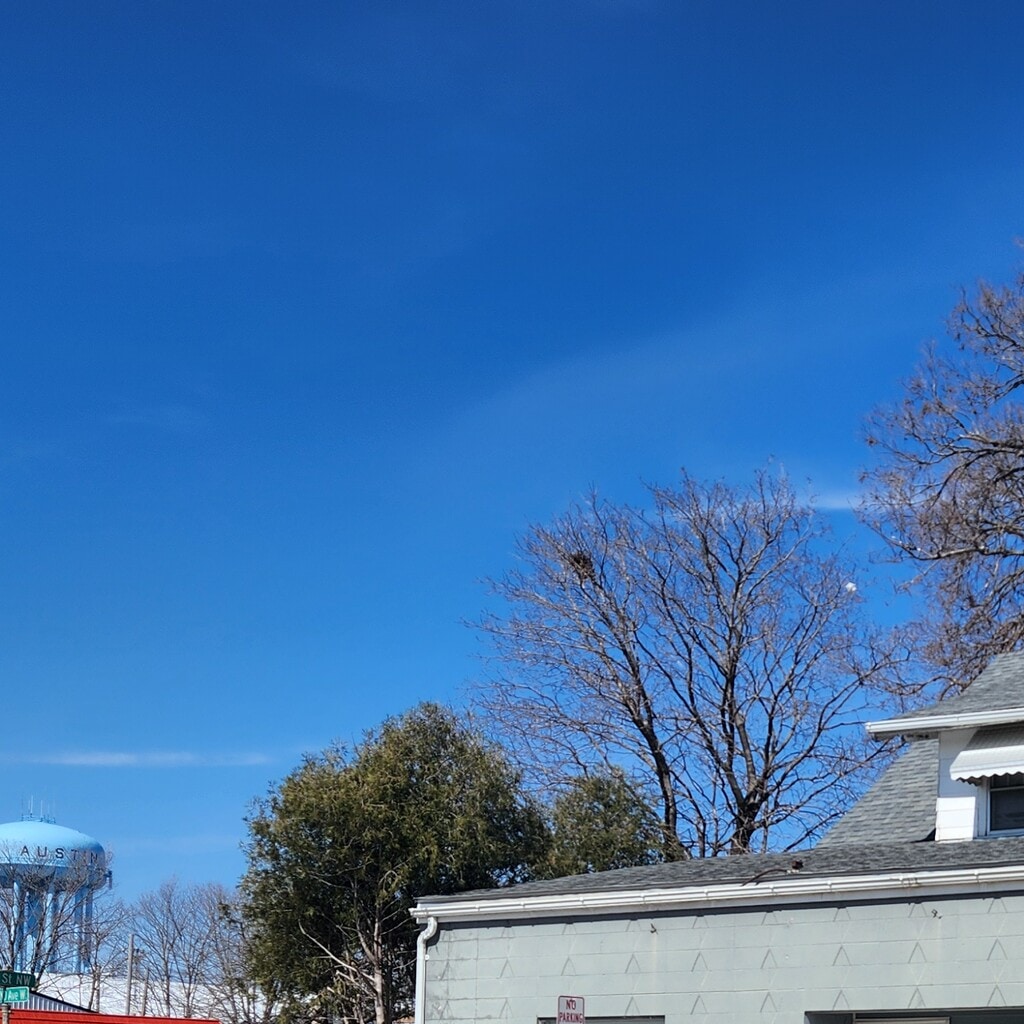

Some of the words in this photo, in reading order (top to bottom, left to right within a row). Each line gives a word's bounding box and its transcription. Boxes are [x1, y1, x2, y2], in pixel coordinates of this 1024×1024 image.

[20, 845, 98, 863] AUSTIN
[1, 972, 12, 984] St
[16, 974, 32, 985] NW
[7, 990, 18, 1001] Ave
[565, 999, 577, 1010] NO
[559, 1012, 583, 1024] PARKING
